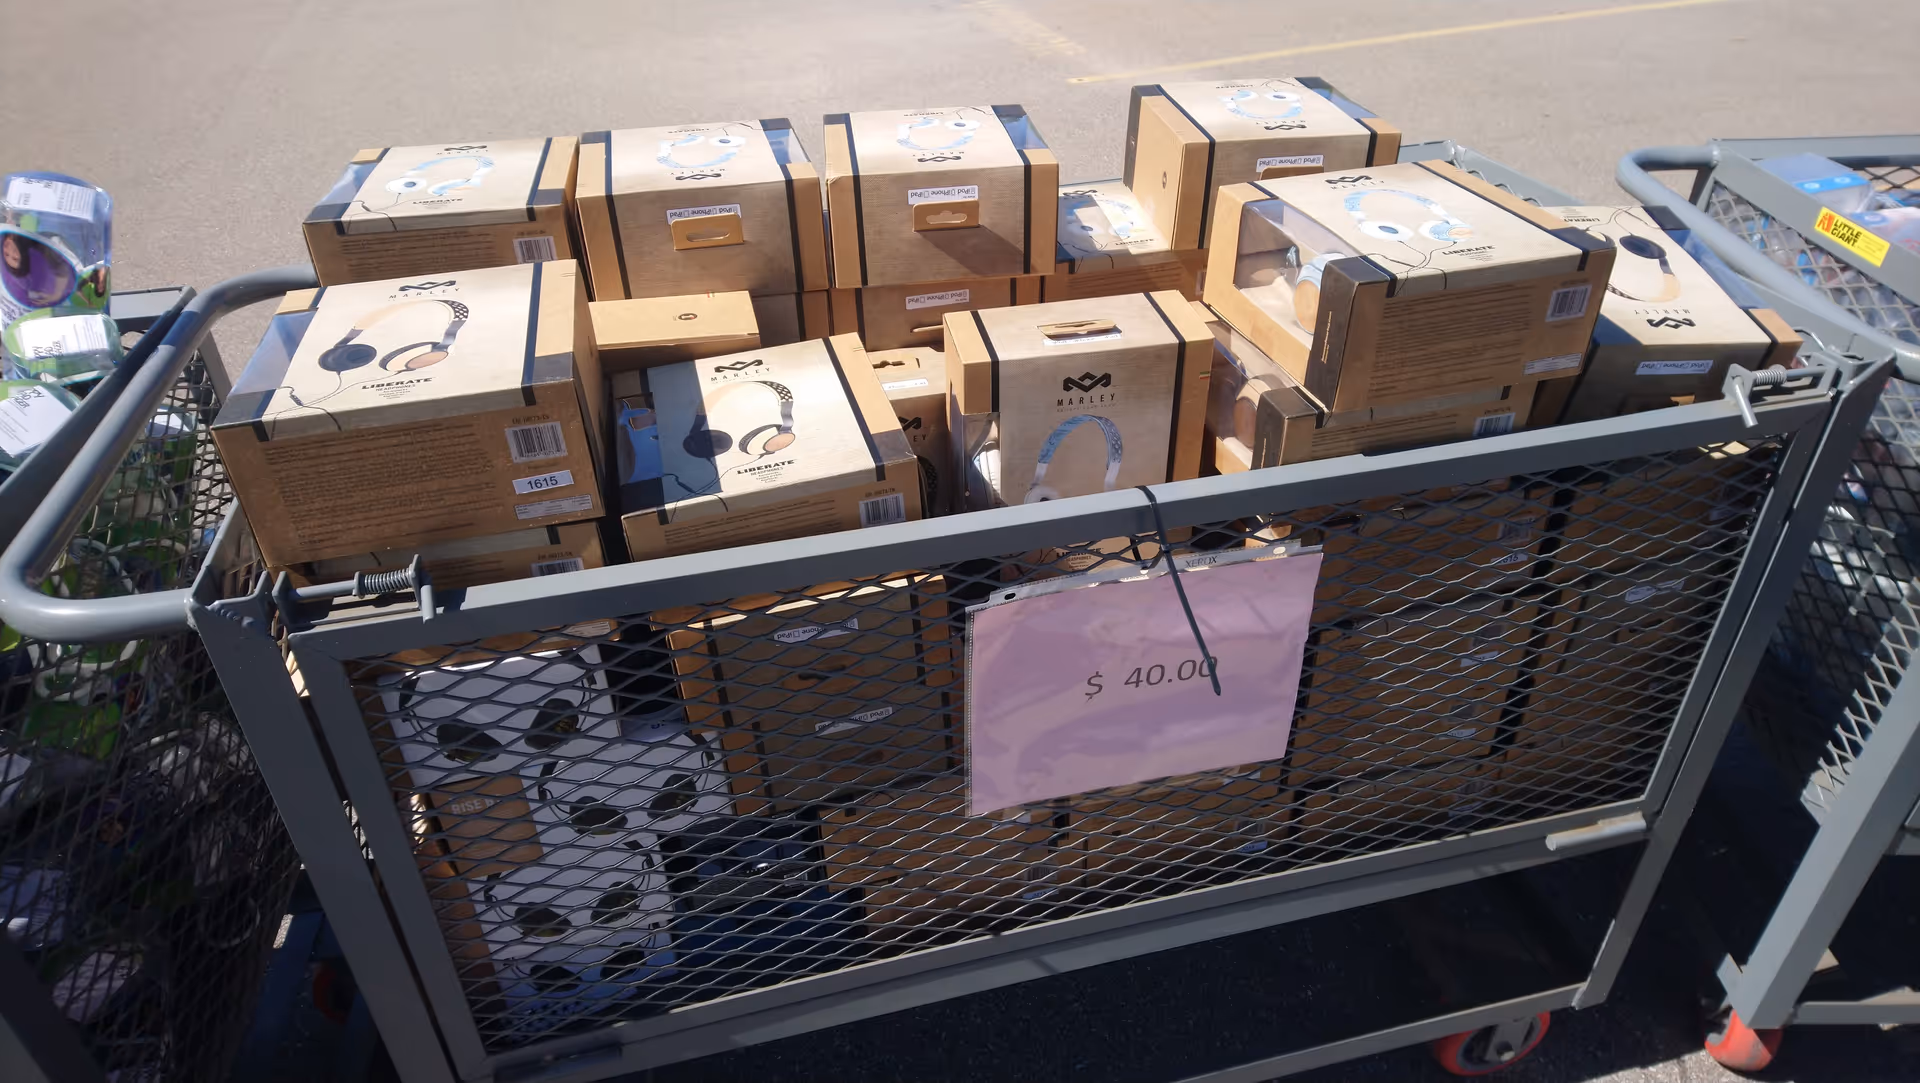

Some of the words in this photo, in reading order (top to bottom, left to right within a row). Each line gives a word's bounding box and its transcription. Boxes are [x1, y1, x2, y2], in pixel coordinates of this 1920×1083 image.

[690, 208, 713, 216] iPhone
[1834, 219, 1863, 240] LITTLE
[1831, 227, 1859, 248] GIANT
[1441, 244, 1496, 256] LIBERATE
[389, 287, 460, 299] MARLEY
[710, 367, 770, 382] MARLEY
[361, 378, 433, 390] LIBERATE
[1057, 393, 1116, 406] MARLEY
[736, 459, 795, 475] LIBERATE
[526, 475, 558, 490] 1615
[1184, 555, 1219, 568] XEROX
[777, 631, 793, 639] iPad
[1084, 670, 1104, 702] $
[1123, 655, 1218, 689] 40.00
